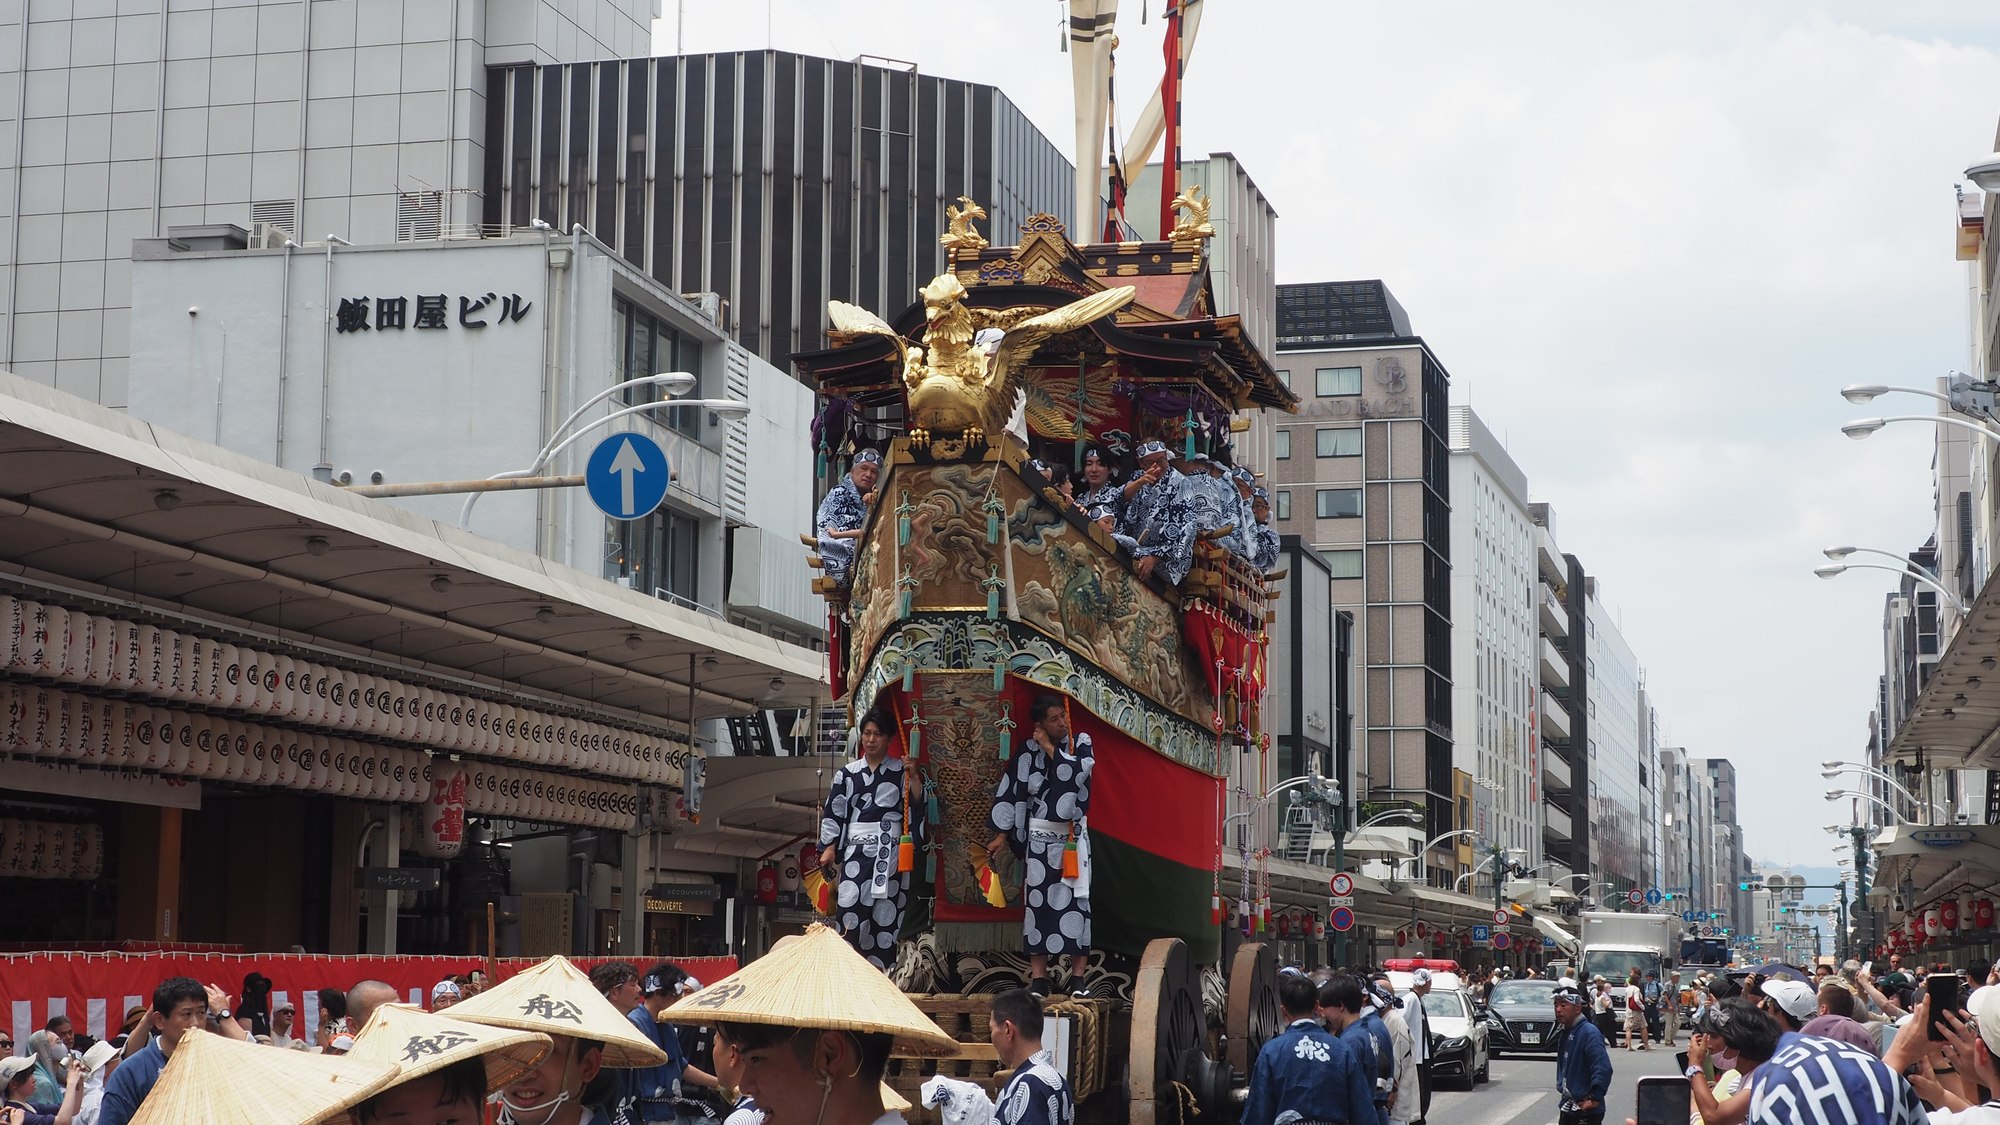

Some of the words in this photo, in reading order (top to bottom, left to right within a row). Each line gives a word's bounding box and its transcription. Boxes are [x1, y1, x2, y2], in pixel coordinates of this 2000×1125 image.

[335, 292, 533, 334] 飯田屋ビル
[1357, 398, 1415, 417] BACH
